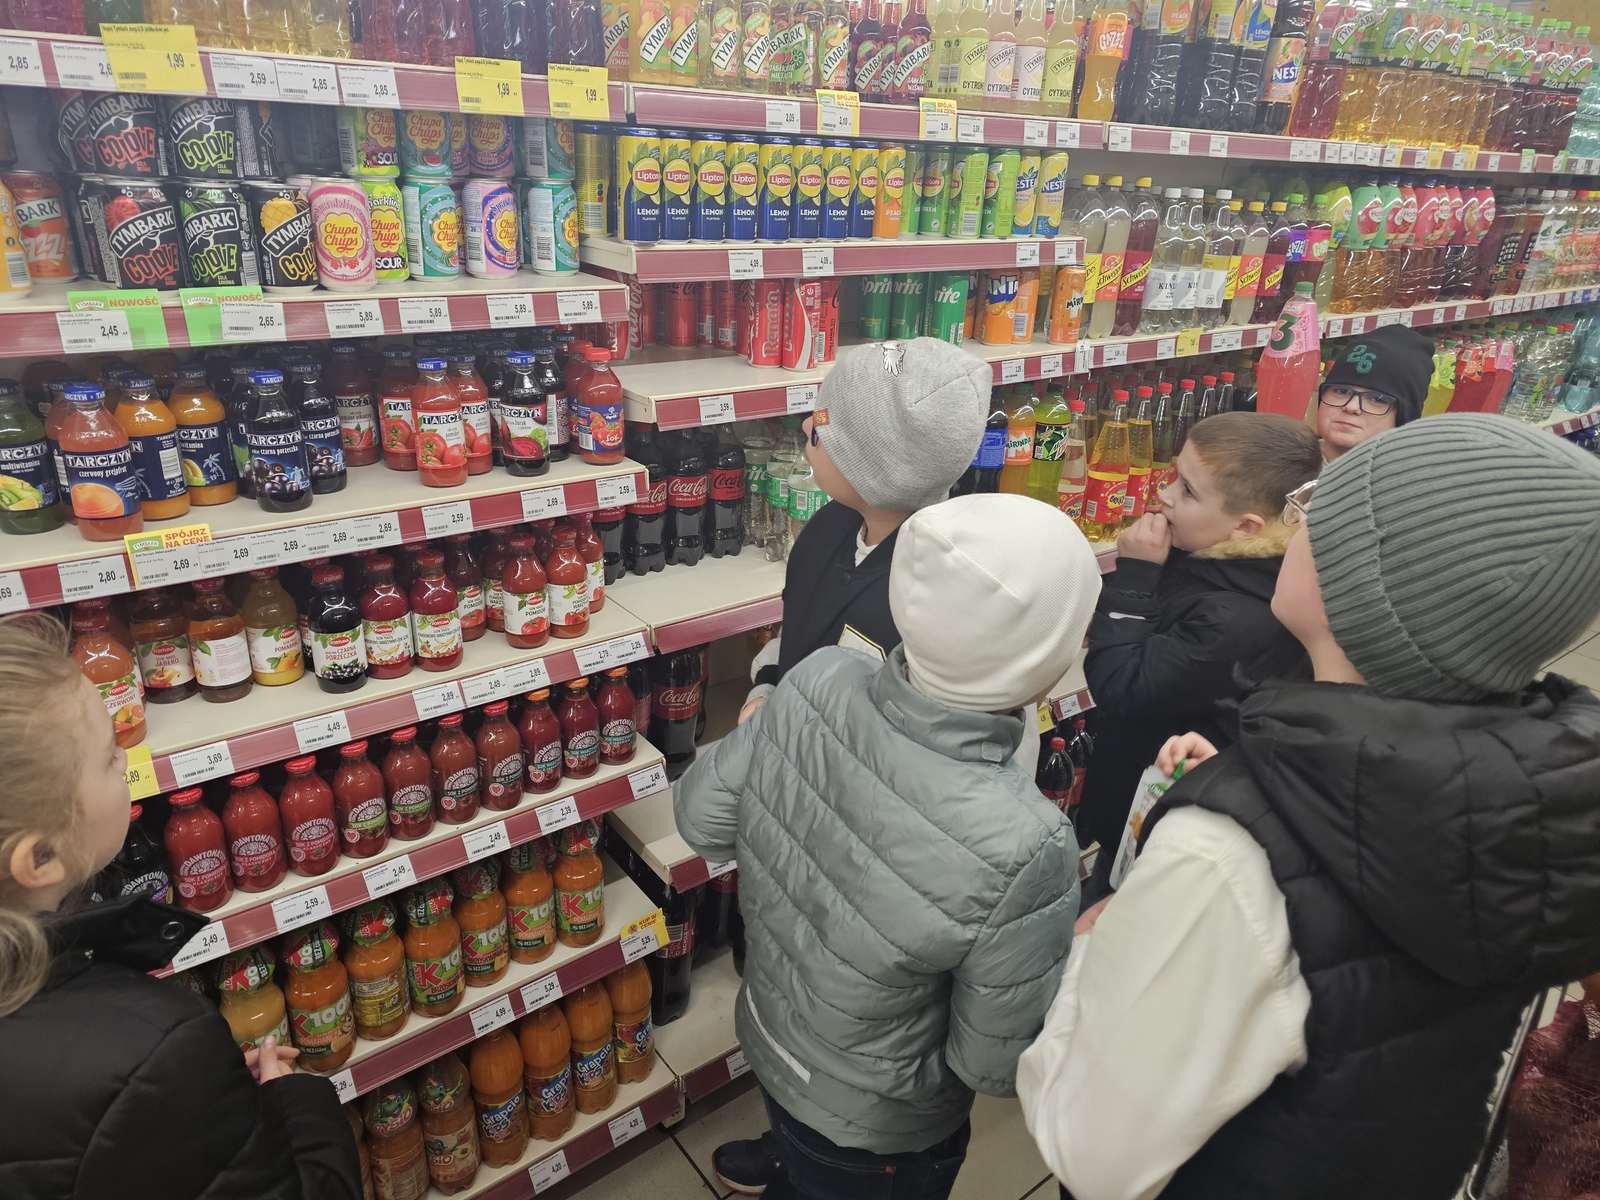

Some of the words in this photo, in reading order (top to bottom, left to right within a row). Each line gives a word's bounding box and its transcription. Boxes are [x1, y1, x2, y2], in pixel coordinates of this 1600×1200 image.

[8, 56, 29, 71] 2,85
[166, 53, 185, 71] 1,99
[249, 71, 267, 87] 2,59
[1272, 65, 1298, 81] NEST
[312, 78, 328, 92] 2,85
[373, 84, 389, 98] 2,85
[496, 82, 511, 98] 1,99
[585, 89, 597, 104] 1,99
[702, 172, 724, 183] Lipton
[771, 174, 791, 185] Lipto
[831, 175, 850, 186] Lipto
[16, 201, 59, 223] BARK
[111, 205, 175, 252] TYMBARK
[186, 209, 236, 244] MBARK
[324, 222, 359, 238] Chupa
[370, 219, 400, 234] Chupa
[324, 232, 361, 252] Chups
[375, 257, 403, 269] SOUR
[108, 295, 159, 308] NOWOŚĆ
[582, 300, 594, 313] 5,89
[429, 307, 443, 321] 5,89
[514, 304, 527, 317] 5,89
[258, 316, 275, 329] 2,65
[359, 311, 373, 326] 5,89
[100, 325, 119, 341] 2,45
[65, 449, 132, 468] TARCZYN
[164, 528, 208, 541] SPÓJRZ
[378, 522, 393, 535] 2,69
[165, 541, 180, 549] NA
[332, 531, 347, 545] 2,69
[233, 547, 249, 561] 2,69
[283, 540, 299, 555] 2,69
[173, 558, 190, 573] 2,69
[98, 570, 116, 585] 2,80
[327, 721, 341, 734] 4,49
[207, 753, 223, 767] 3,69
[304, 897, 319, 910] 2,59
[202, 933, 218, 947] 2,49
